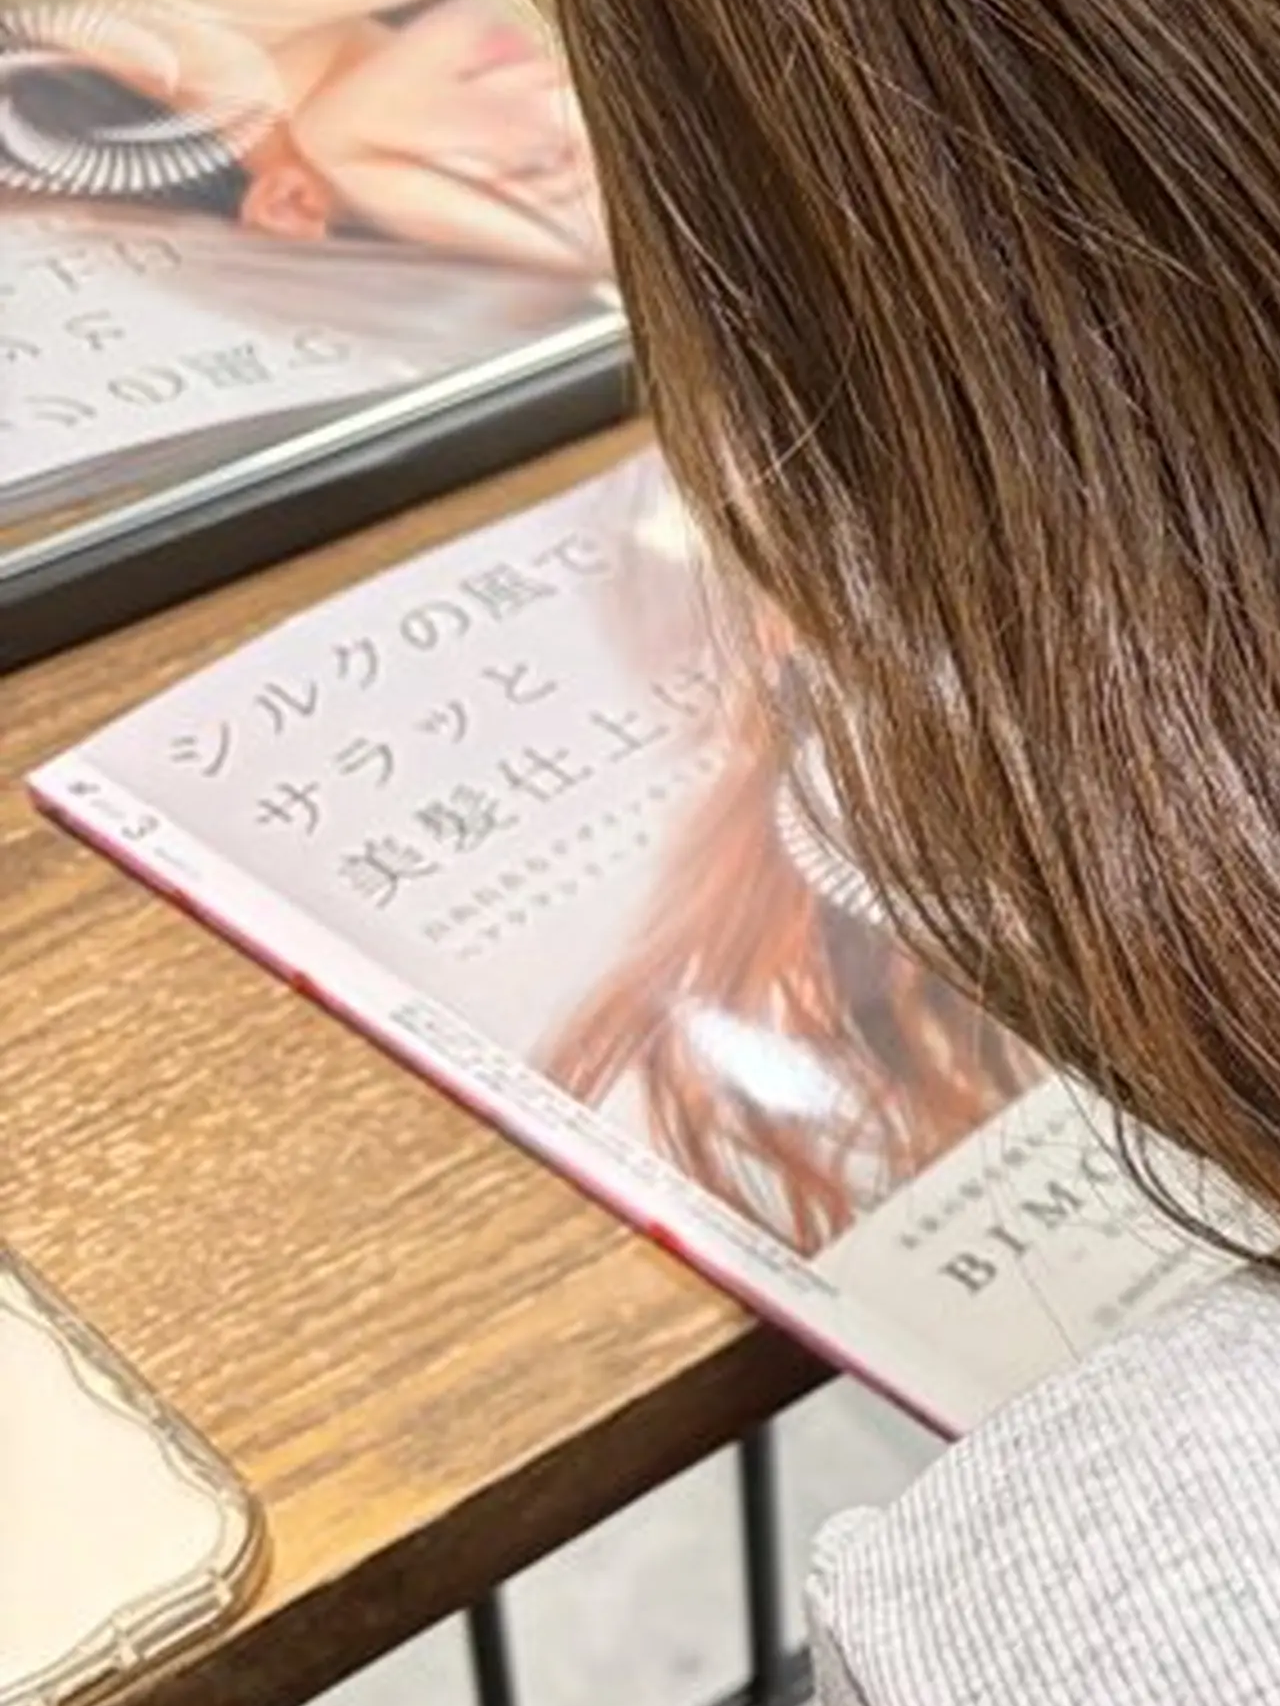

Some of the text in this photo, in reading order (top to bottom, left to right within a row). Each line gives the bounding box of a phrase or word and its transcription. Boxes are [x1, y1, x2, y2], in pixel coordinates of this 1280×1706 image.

[168, 531, 612, 778] シルクの風で
[255, 661, 558, 836] サラッと
